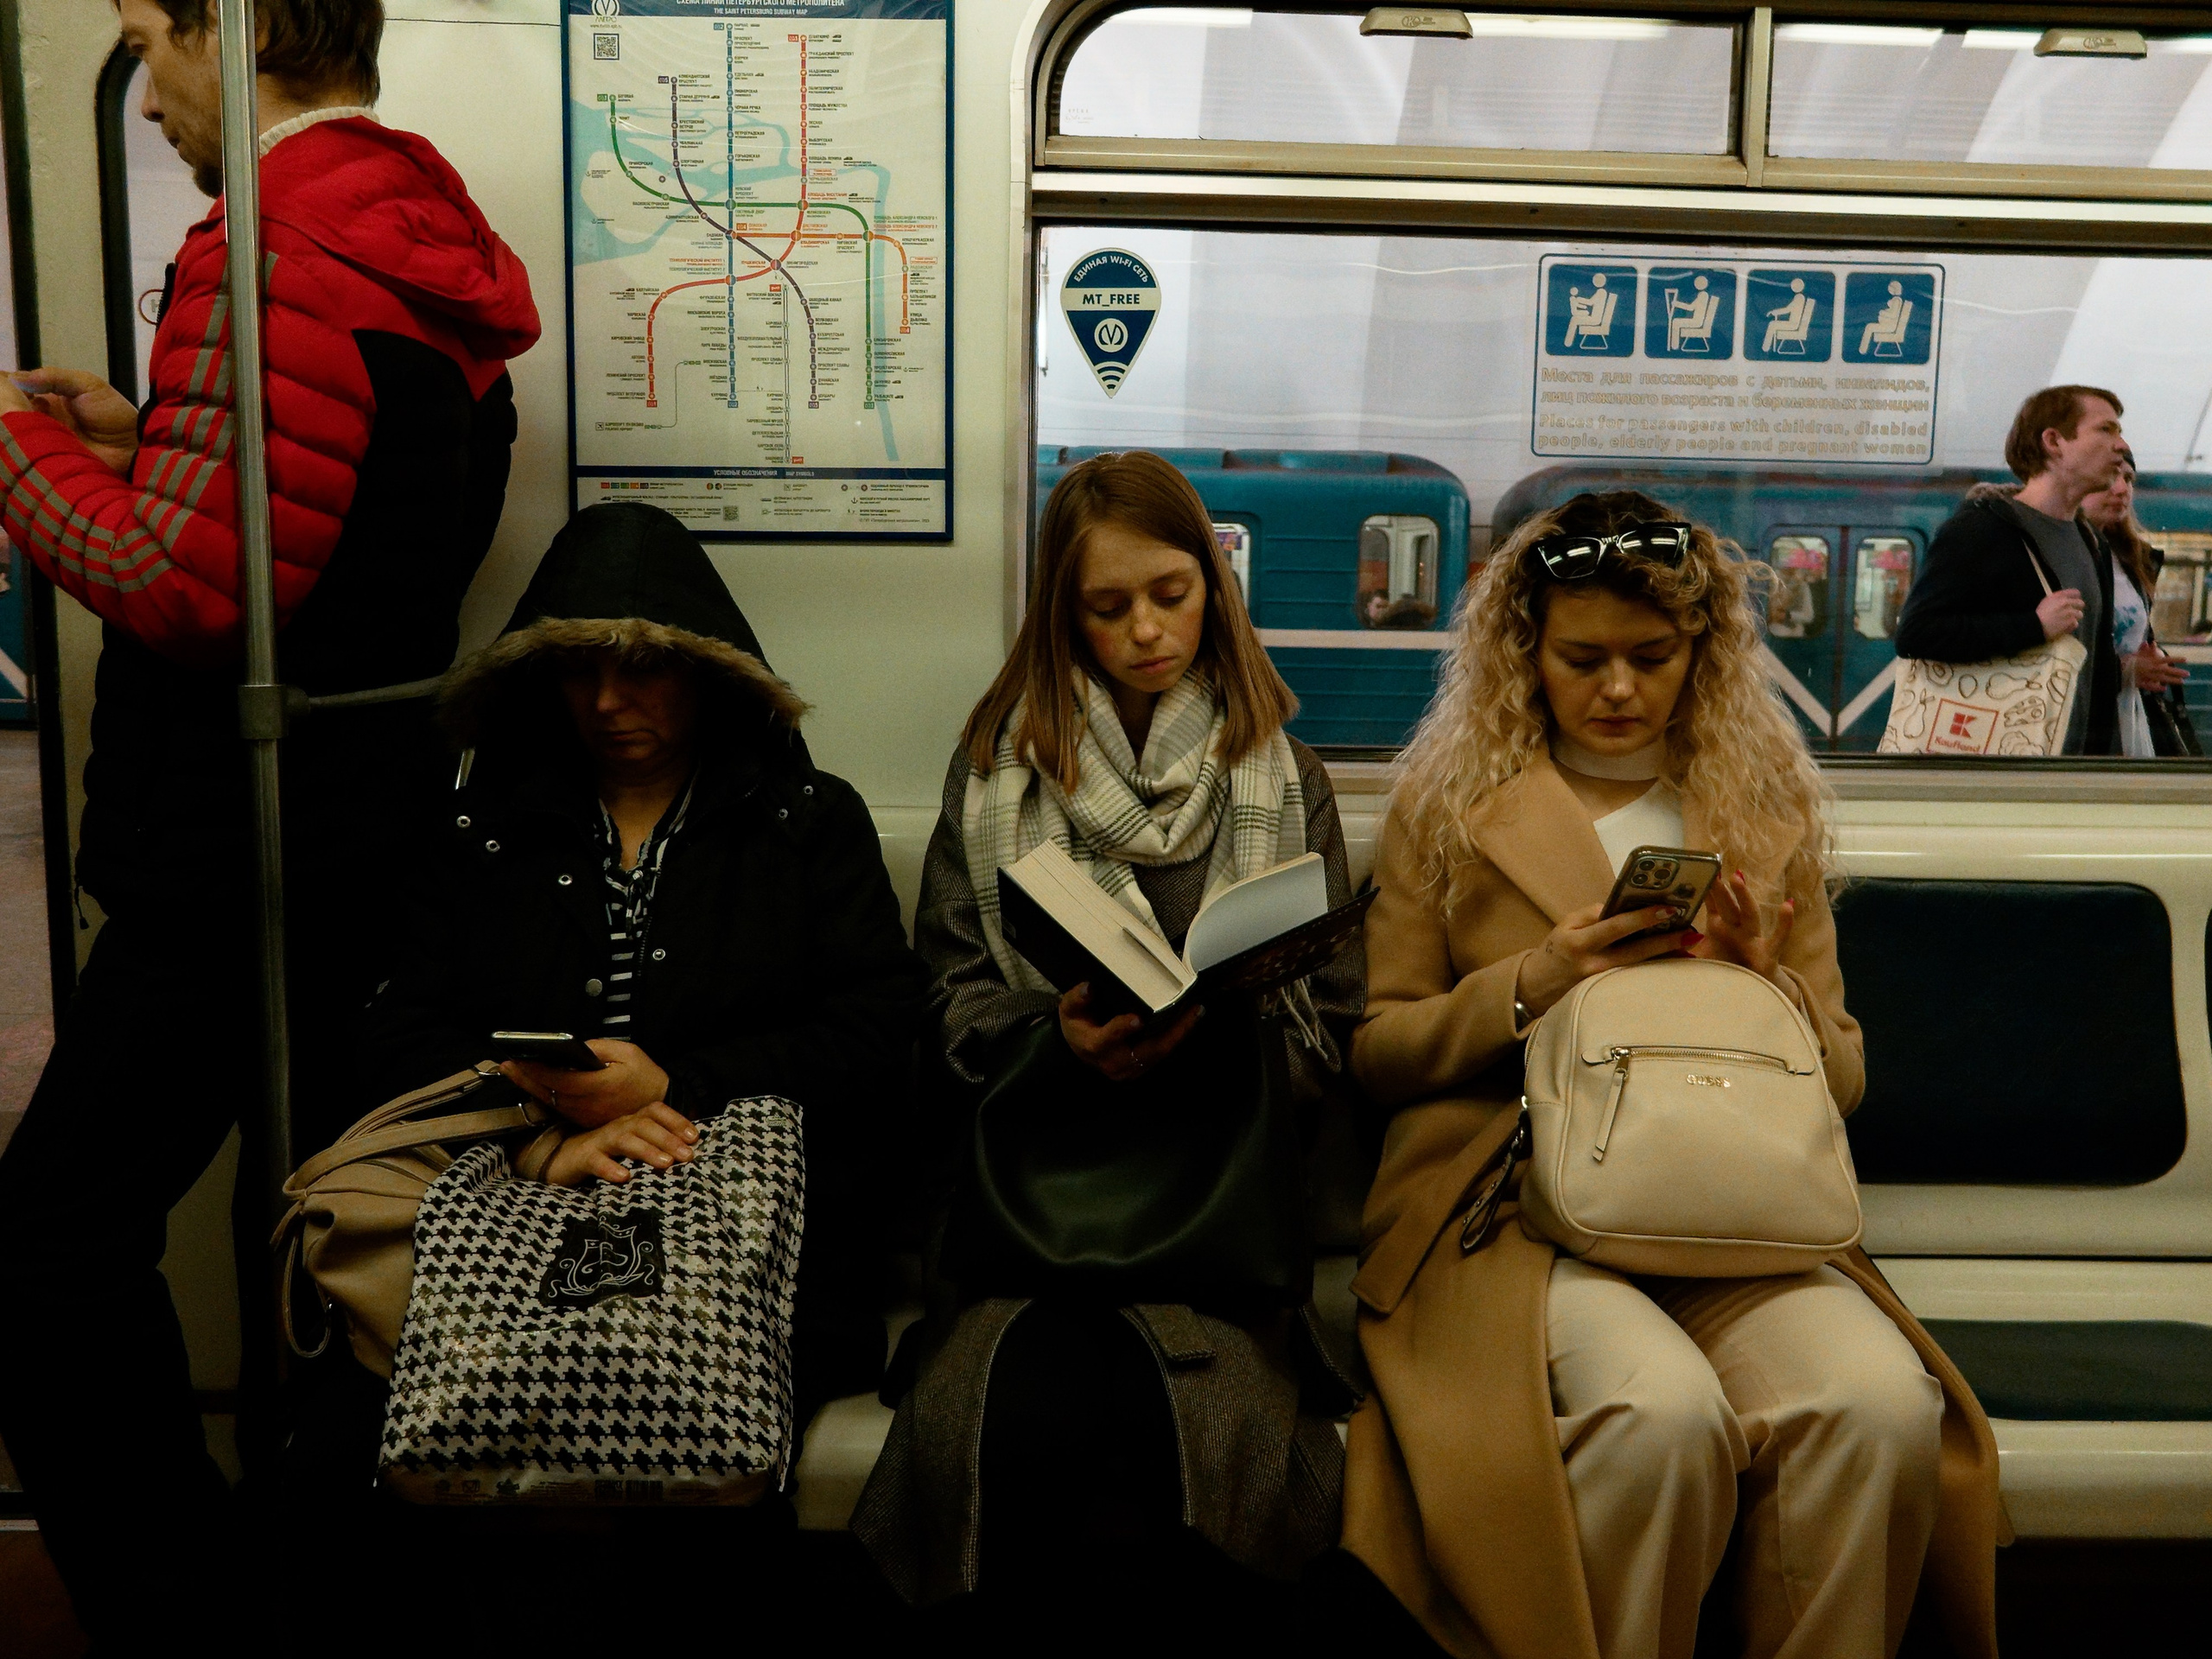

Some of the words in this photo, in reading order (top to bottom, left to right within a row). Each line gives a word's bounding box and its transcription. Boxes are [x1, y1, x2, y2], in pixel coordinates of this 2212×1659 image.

[1074, 256, 1108, 283] ЕДИНАЯ
[1110, 256, 1132, 267] WI-FI
[1133, 264, 1148, 283] СЕТЬ
[1083, 294, 1140, 307] MT_FREE
[1541, 367, 1594, 383] Места
[1600, 372, 1632, 386] для
[1640, 372, 1738, 390] пассажиров
[1746, 375, 1755, 387] с
[1762, 375, 1827, 391] детьми,
[1541, 391, 1573, 406] лиц
[1577, 391, 1659, 406] пожилого
[1662, 393, 1734, 410] возраста
[1738, 395, 1749, 407] и
[1752, 392, 1856, 412] беременных
[1859, 397, 1929, 414] женщин
[1539, 414, 1594, 429] Places
[1598, 414, 1624, 429] for
[1628, 417, 1726, 434] passengers
[1730, 418, 1769, 433] with
[1773, 418, 1850, 435] children,
[1853, 421, 1928, 436] disabled
[1538, 433, 1604, 449] people,
[1609, 434, 1671, 452] elderly
[1675, 436, 1735, 453] people
[1740, 438, 1773, 452] and
[1778, 439, 1858, 456] pregnant
[1863, 442, 1927, 455] women
